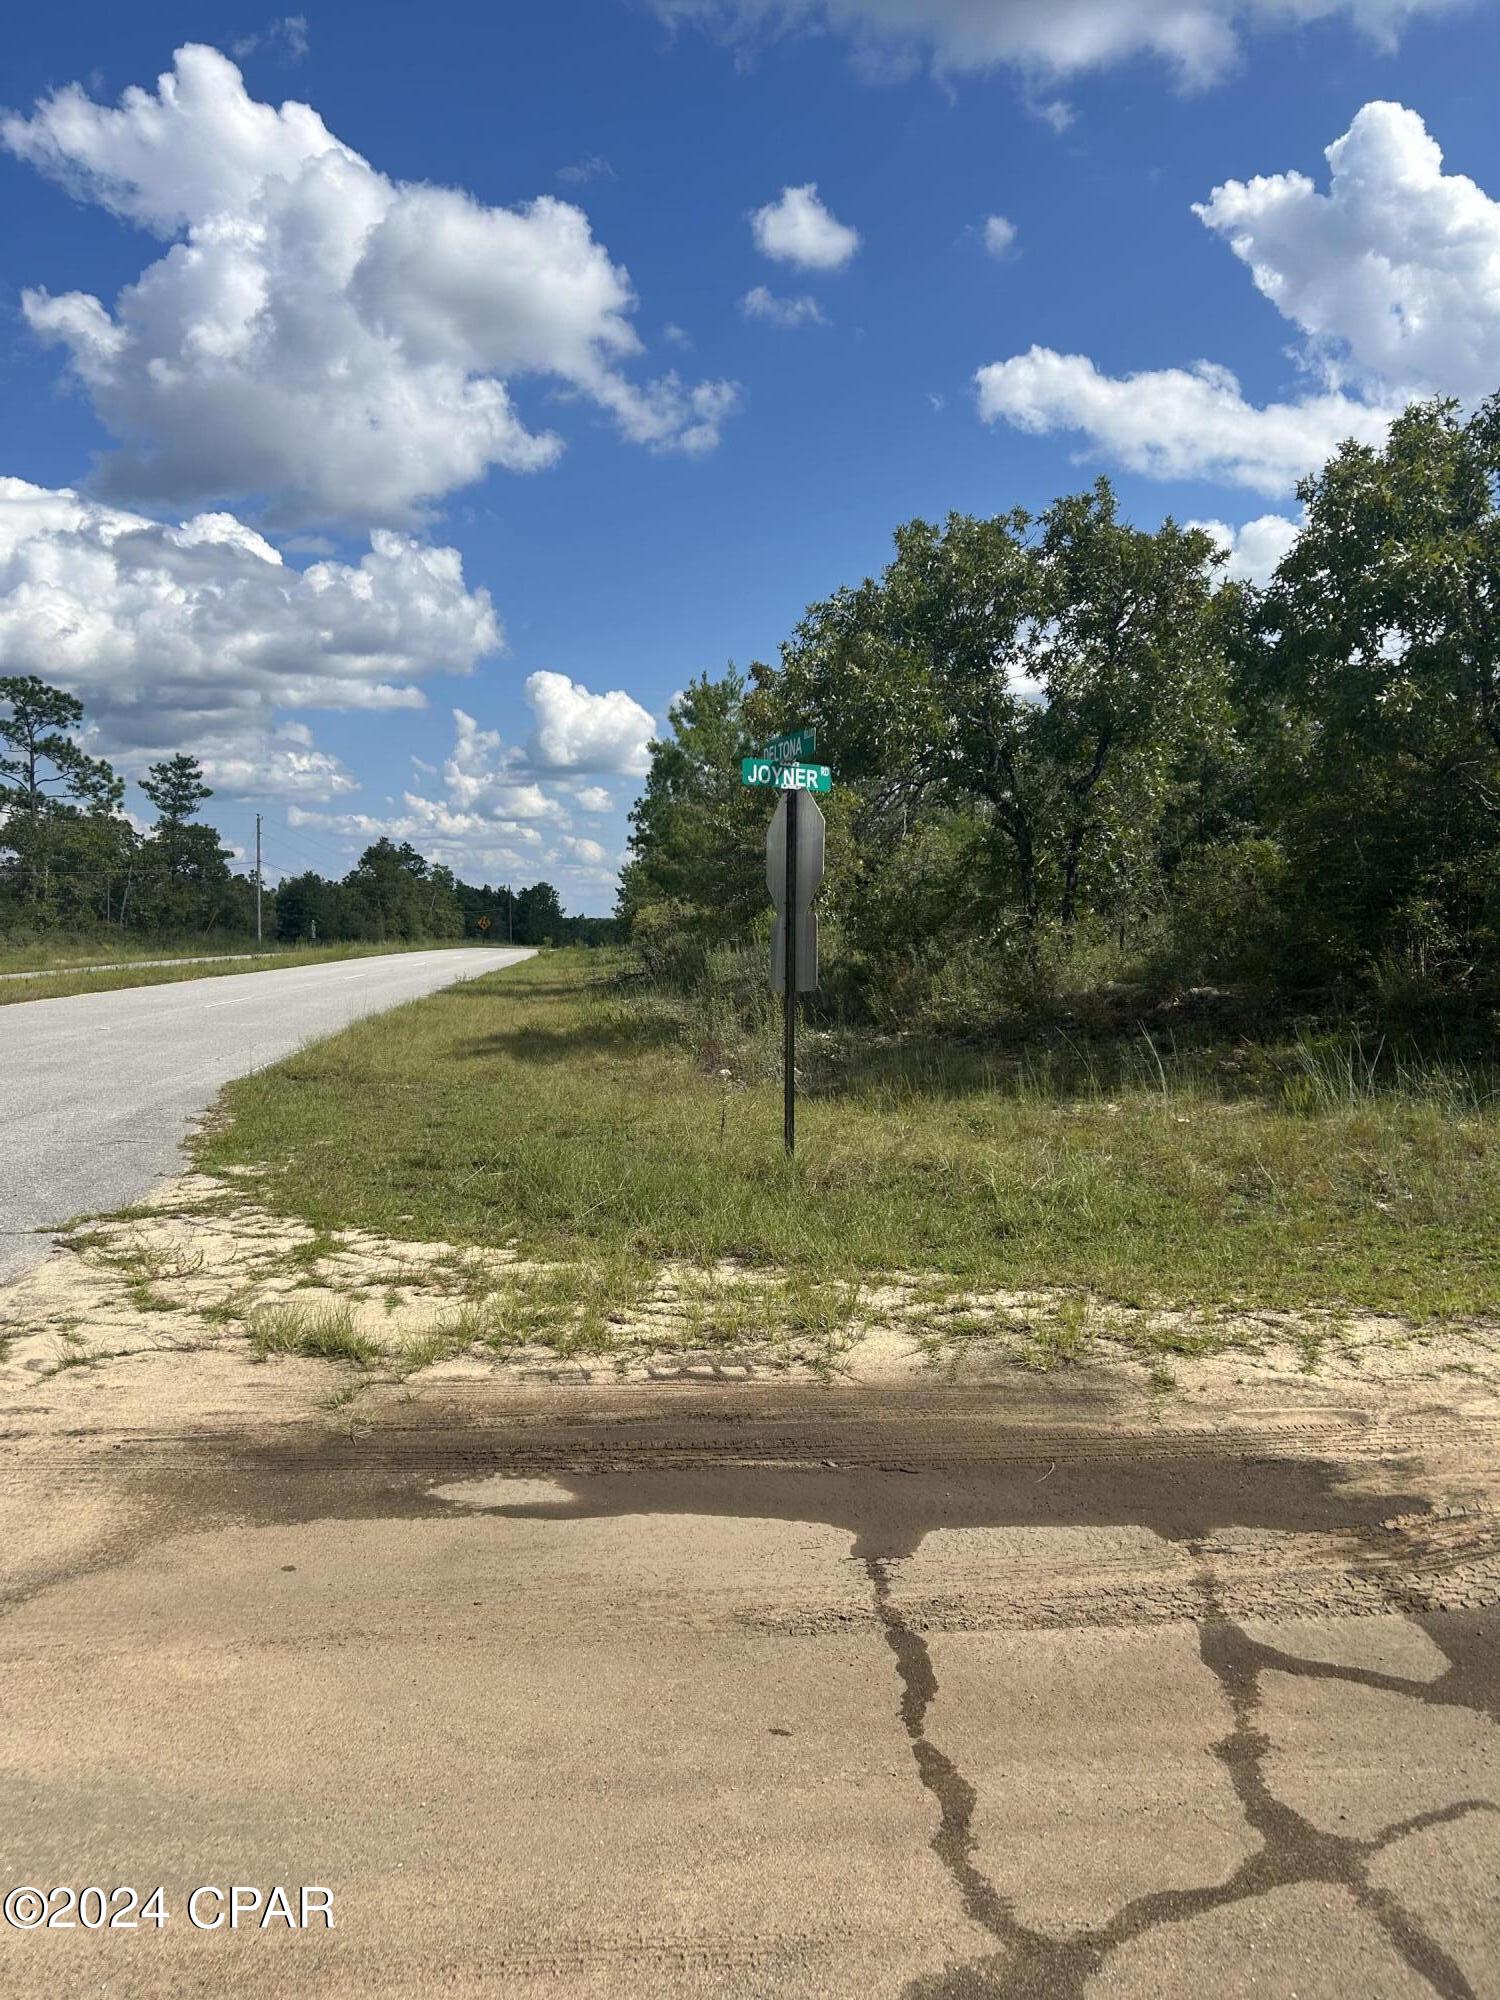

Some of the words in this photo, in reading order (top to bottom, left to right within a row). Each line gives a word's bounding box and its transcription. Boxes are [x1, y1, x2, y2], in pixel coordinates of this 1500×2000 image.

[763, 737, 802, 761] DELTONA
[748, 764, 818, 788] JOYNER
[820, 766, 830, 777] RD
